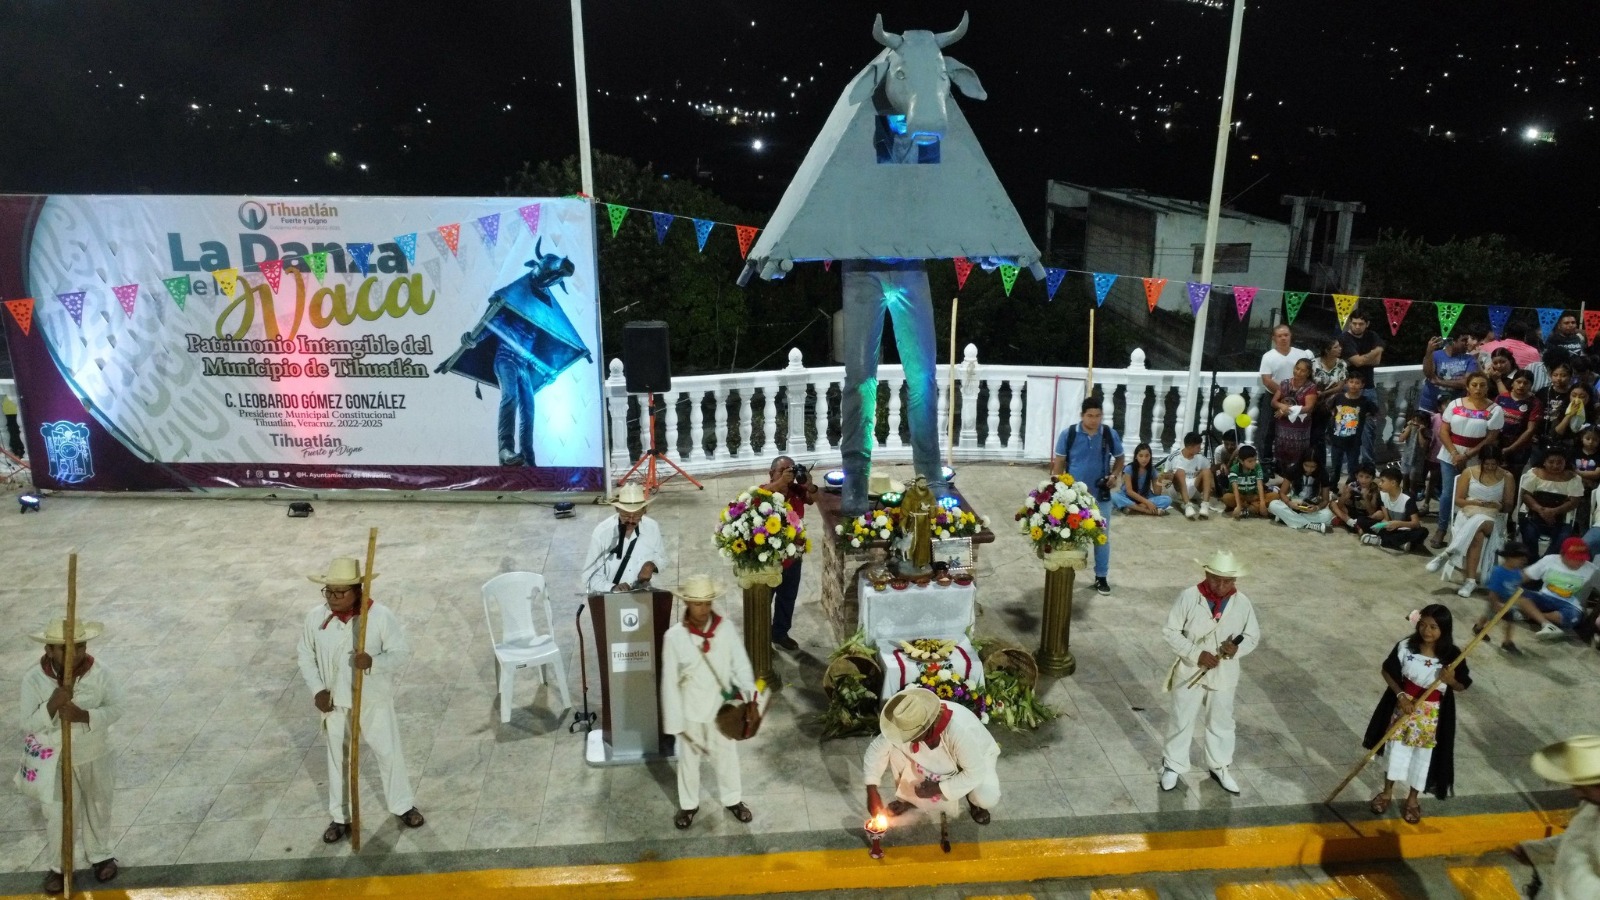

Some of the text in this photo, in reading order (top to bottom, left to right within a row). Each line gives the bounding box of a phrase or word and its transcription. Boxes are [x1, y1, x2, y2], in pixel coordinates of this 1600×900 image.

[267, 202, 338, 217] Tihuatlán
[308, 217, 327, 225] Digno
[167, 232, 231, 273] La
[214, 265, 436, 343] Vaca
[186, 333, 433, 358] Patrimonio Intangible del
[203, 356, 429, 381] Municipio de Tihuatlán
[224, 391, 406, 410] C. LEOBARDO GÓMEZ GONZÁLEZ
[239, 409, 396, 420] Presidente Municipal Constitucional
[253, 418, 297, 428] Tihuatlán,
[337, 419, 383, 428] 2022-2025
[269, 433, 342, 448] Tihuatlán
[301, 444, 363, 458] Fuerte y Digno
[309, 472, 352, 480] Ayuntamiento
